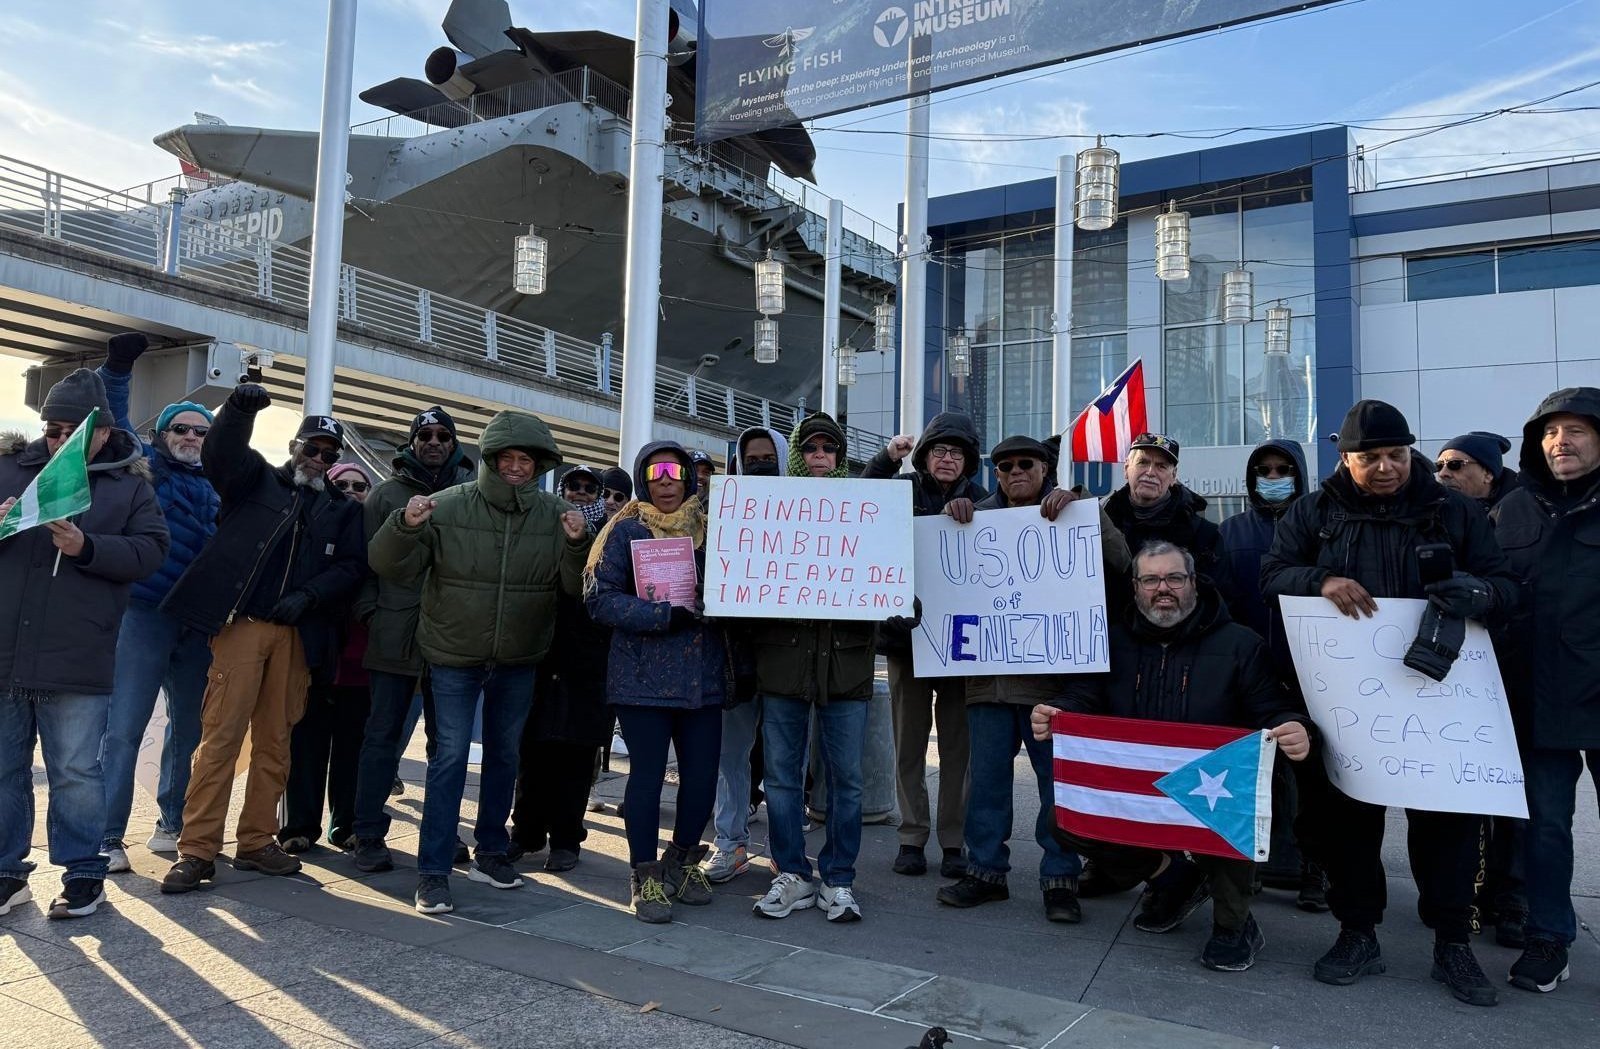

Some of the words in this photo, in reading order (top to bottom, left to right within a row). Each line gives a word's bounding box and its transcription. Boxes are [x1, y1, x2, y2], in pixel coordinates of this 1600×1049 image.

[914, 0, 1010, 38] MUSEUM
[738, 61, 797, 87] FLYING
[803, 48, 842, 72] FISH
[741, 90, 779, 107] Mysteries
[780, 87, 800, 98] from
[801, 82, 815, 93] the
[815, 77, 839, 89] Deep:
[841, 67, 880, 83] Exploring
[881, 53, 935, 72] Underwater
[935, 38, 998, 60] Archaeology
[998, 34, 1007, 44] is
[1008, 33, 1016, 41] a
[729, 105, 763, 121] traveling
[763, 99, 800, 114] exhibition
[801, 86, 854, 107] co-produced
[856, 83, 868, 94] by
[869, 77, 894, 90] Flying
[895, 71, 912, 82] Fish
[914, 67, 931, 78] and
[933, 63, 948, 73] the
[950, 54, 986, 69] Intrepid
[717, 525, 859, 558] LAMBON
[1017, 524, 1101, 583] OUT
[719, 556, 730, 579] Y
[746, 558, 854, 583] LACAYO
[868, 566, 907, 584] DEL
[993, 591, 1022, 611] of
[920, 604, 1109, 667] VENEZUELA
[1329, 706, 1494, 744] PEACE
[1379, 756, 1435, 779] OFF
